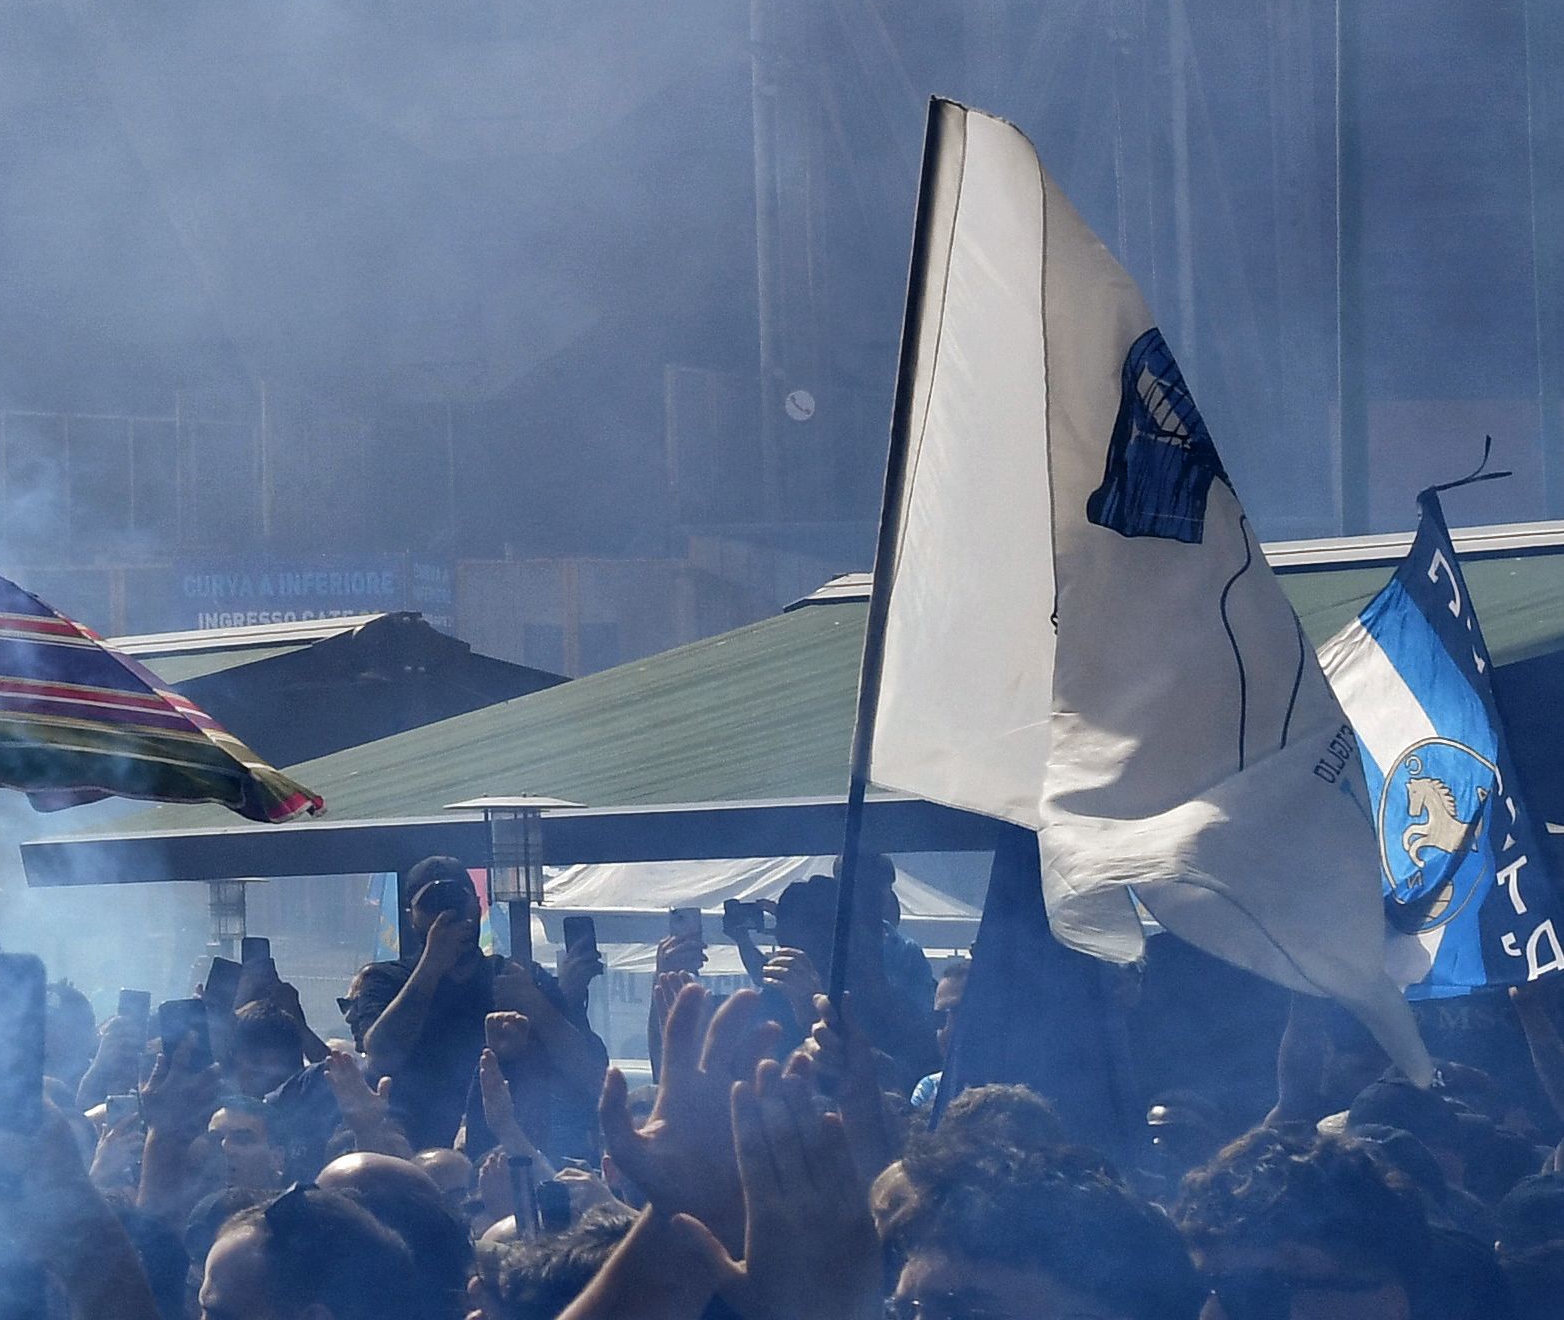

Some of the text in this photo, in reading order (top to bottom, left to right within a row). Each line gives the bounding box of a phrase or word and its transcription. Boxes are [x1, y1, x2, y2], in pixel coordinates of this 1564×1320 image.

[183, 573, 253, 597] CURVA
[261, 573, 275, 597] A
[281, 570, 396, 596] INFERIORE
